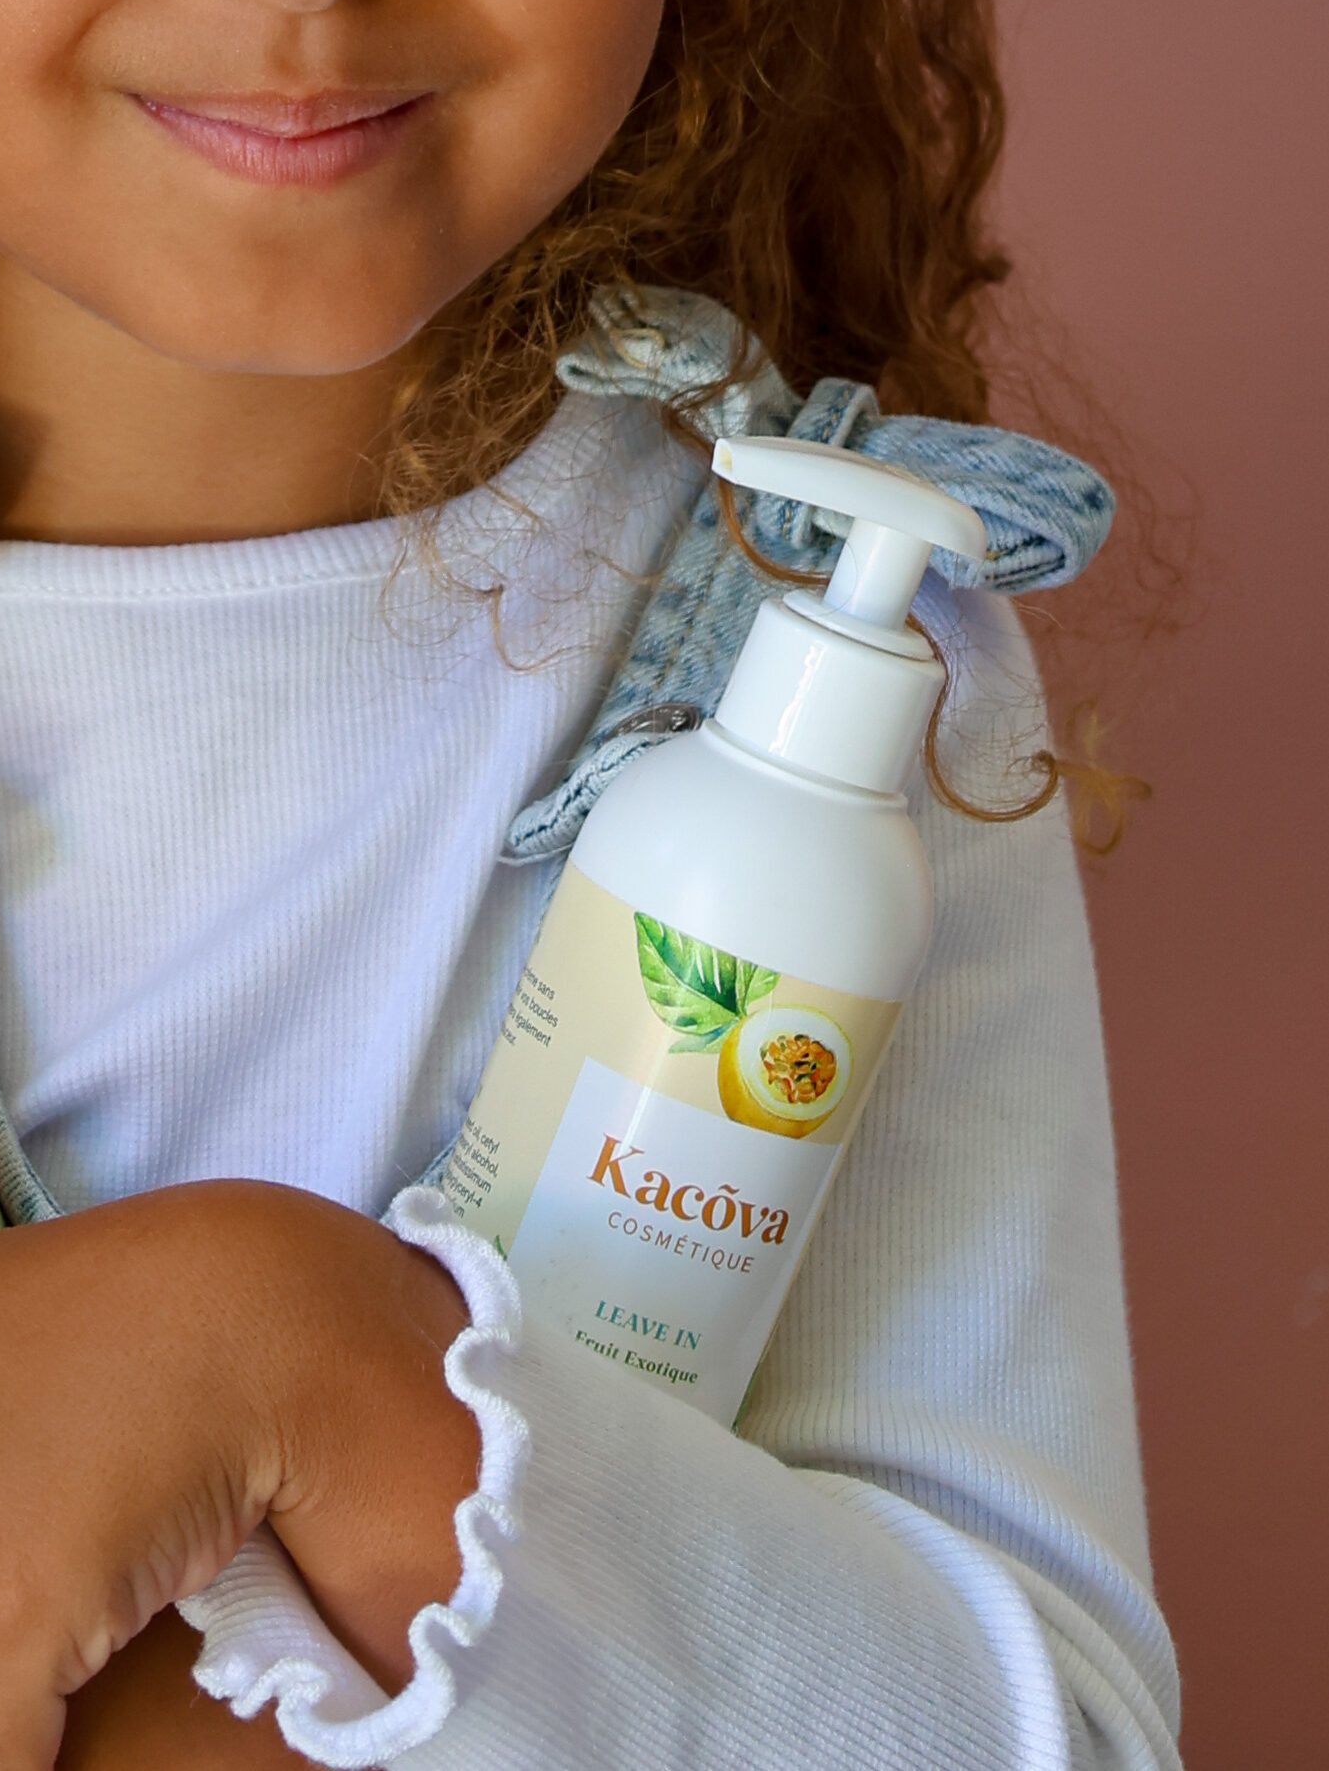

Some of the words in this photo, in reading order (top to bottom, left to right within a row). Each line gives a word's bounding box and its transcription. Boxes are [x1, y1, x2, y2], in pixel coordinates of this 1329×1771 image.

[528, 997, 559, 1028] boucles
[480, 1133, 500, 1155] cetyl
[586, 1133, 790, 1245] Kacõva
[608, 1211, 755, 1273] COSMÉTIQUE
[595, 1300, 670, 1343] LEAVE
[673, 1328, 702, 1350] IN
[575, 1329, 619, 1360] Fruit
[624, 1349, 699, 1384] Exotique
